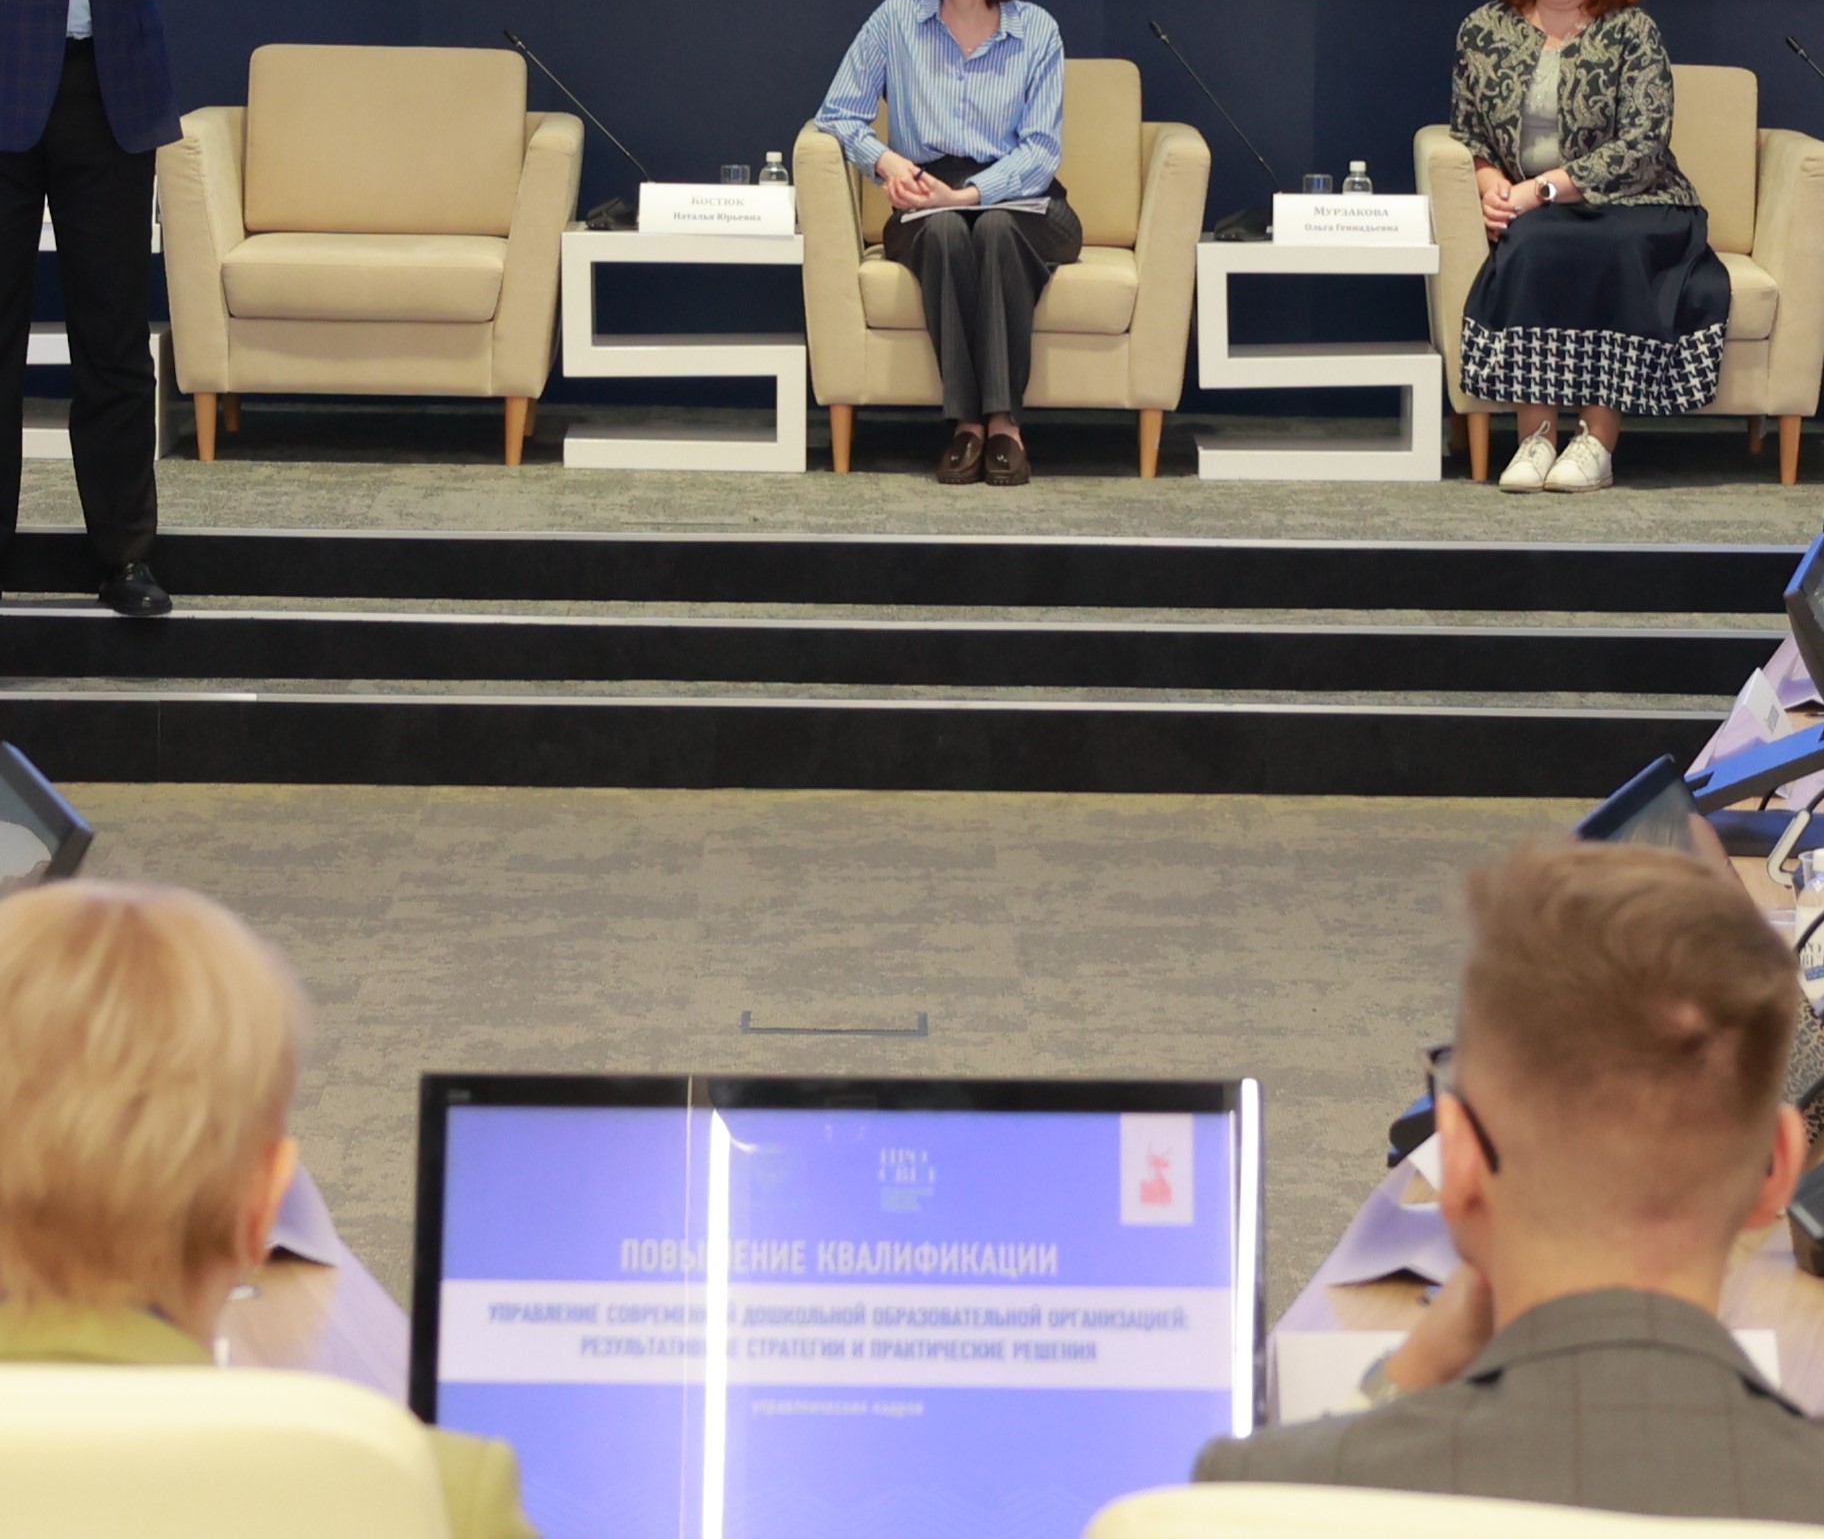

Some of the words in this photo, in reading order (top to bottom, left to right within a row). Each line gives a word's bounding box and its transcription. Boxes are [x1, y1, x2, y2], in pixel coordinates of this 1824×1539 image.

[673, 211, 715, 221] Наталья
[716, 212, 762, 223] Юрьевна
[1304, 223, 1334, 233] Ольга
[1335, 223, 1399, 234] Геннадьевна
[621, 1238, 807, 1274] ПОВЫЕНИЕ
[817, 1240, 1060, 1278] КВАЛИФИКАЦИИ
[488, 1302, 600, 1325] УПРАВЛЕНИЕ
[742, 1301, 866, 1329] ДОШКОЛЬНОЙ
[872, 1304, 1042, 1329] ОБРАЗОВАТЕЛЬНОЙ
[746, 1336, 846, 1359] СТРАТЕГИИ
[853, 1338, 864, 1359] И
[870, 1339, 1005, 1361] ПРАКТИЧЕСКИЕ
[1012, 1340, 1097, 1362] РЕШЕНИЯ
